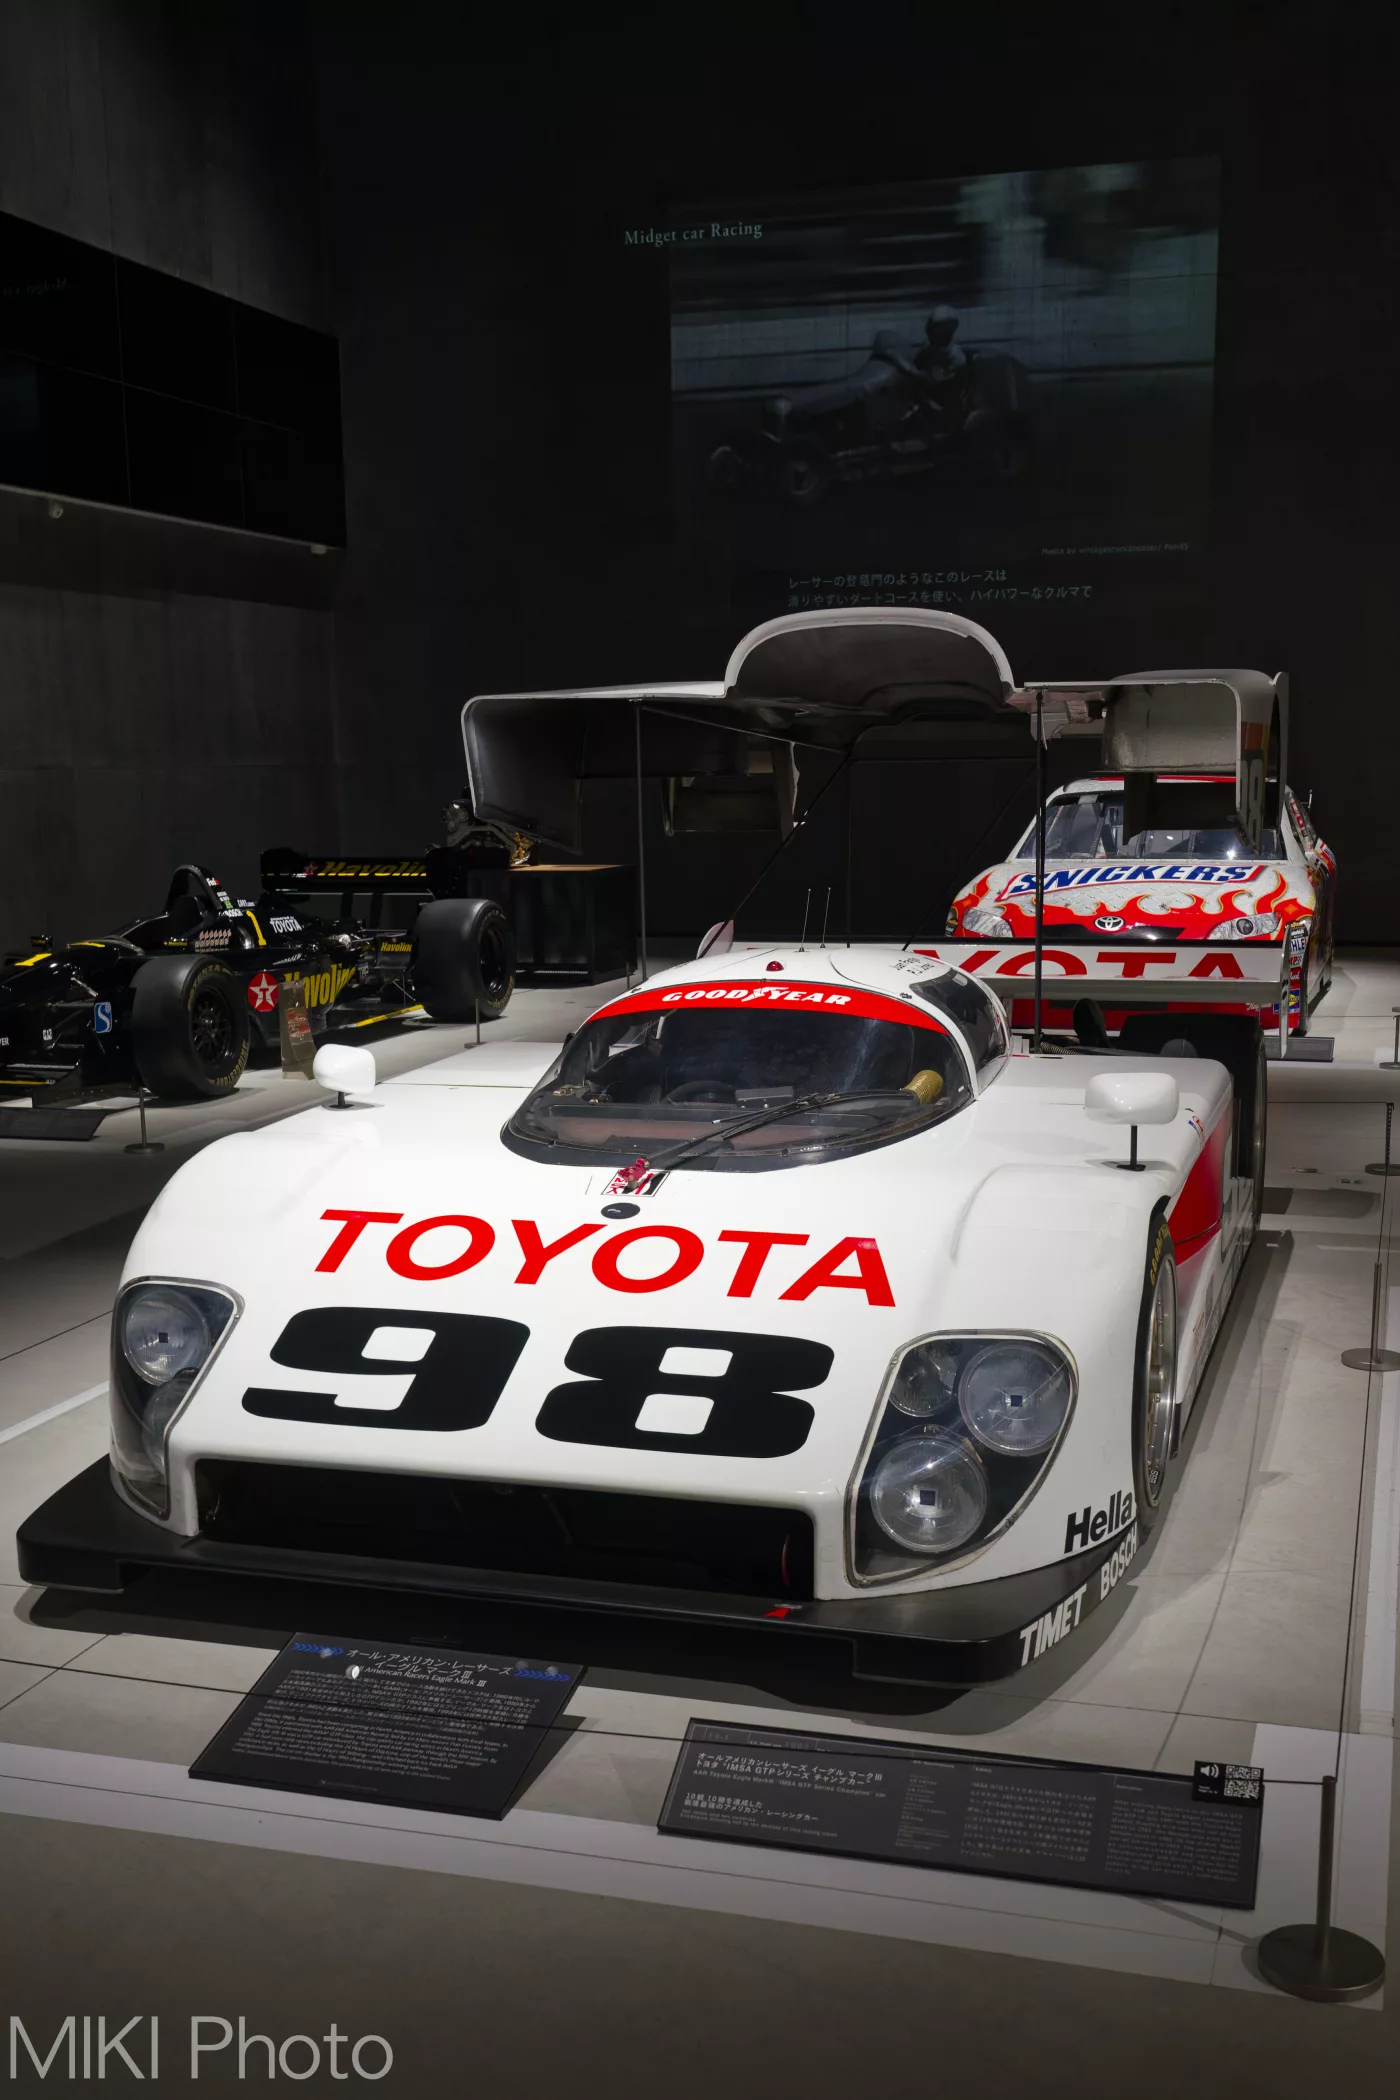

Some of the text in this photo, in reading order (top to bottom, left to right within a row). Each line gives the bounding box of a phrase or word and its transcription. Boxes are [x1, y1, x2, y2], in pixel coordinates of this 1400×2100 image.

[624, 222, 763, 248] Midget car Racing
[1066, 547, 1076, 556] by
[789, 569, 1008, 589] レーサーの登竜門のようなこのレースは
[1009, 866, 1253, 894] SNICKERS
[269, 918, 303, 934] TOYOTA
[316, 1210, 895, 1306] TOYOTA
[242, 1307, 834, 1458] 98
[1064, 1490, 1133, 1554] Hella
[1100, 1522, 1138, 1601] BOSCH
[1020, 1583, 1087, 1667] TIMET
[346, 1649, 514, 1677] オール・アメリカン・レーサーズ
[364, 1665, 402, 1677] American
[403, 1671, 430, 1681] Racers
[431, 1674, 453, 1684] Eagle
[453, 1677, 475, 1686] Mark
[375, 1661, 422, 1673] イーグル
[696, 1760, 719, 1769] トヨタ
[755, 1767, 811, 1780] GTPシリーズ
[698, 1752, 809, 1773] オールアメリカンレーサーズ
[811, 1765, 844, 1776] イーグル
[709, 1770, 731, 1779] Toyota
[813, 1783, 835, 1792] Series
